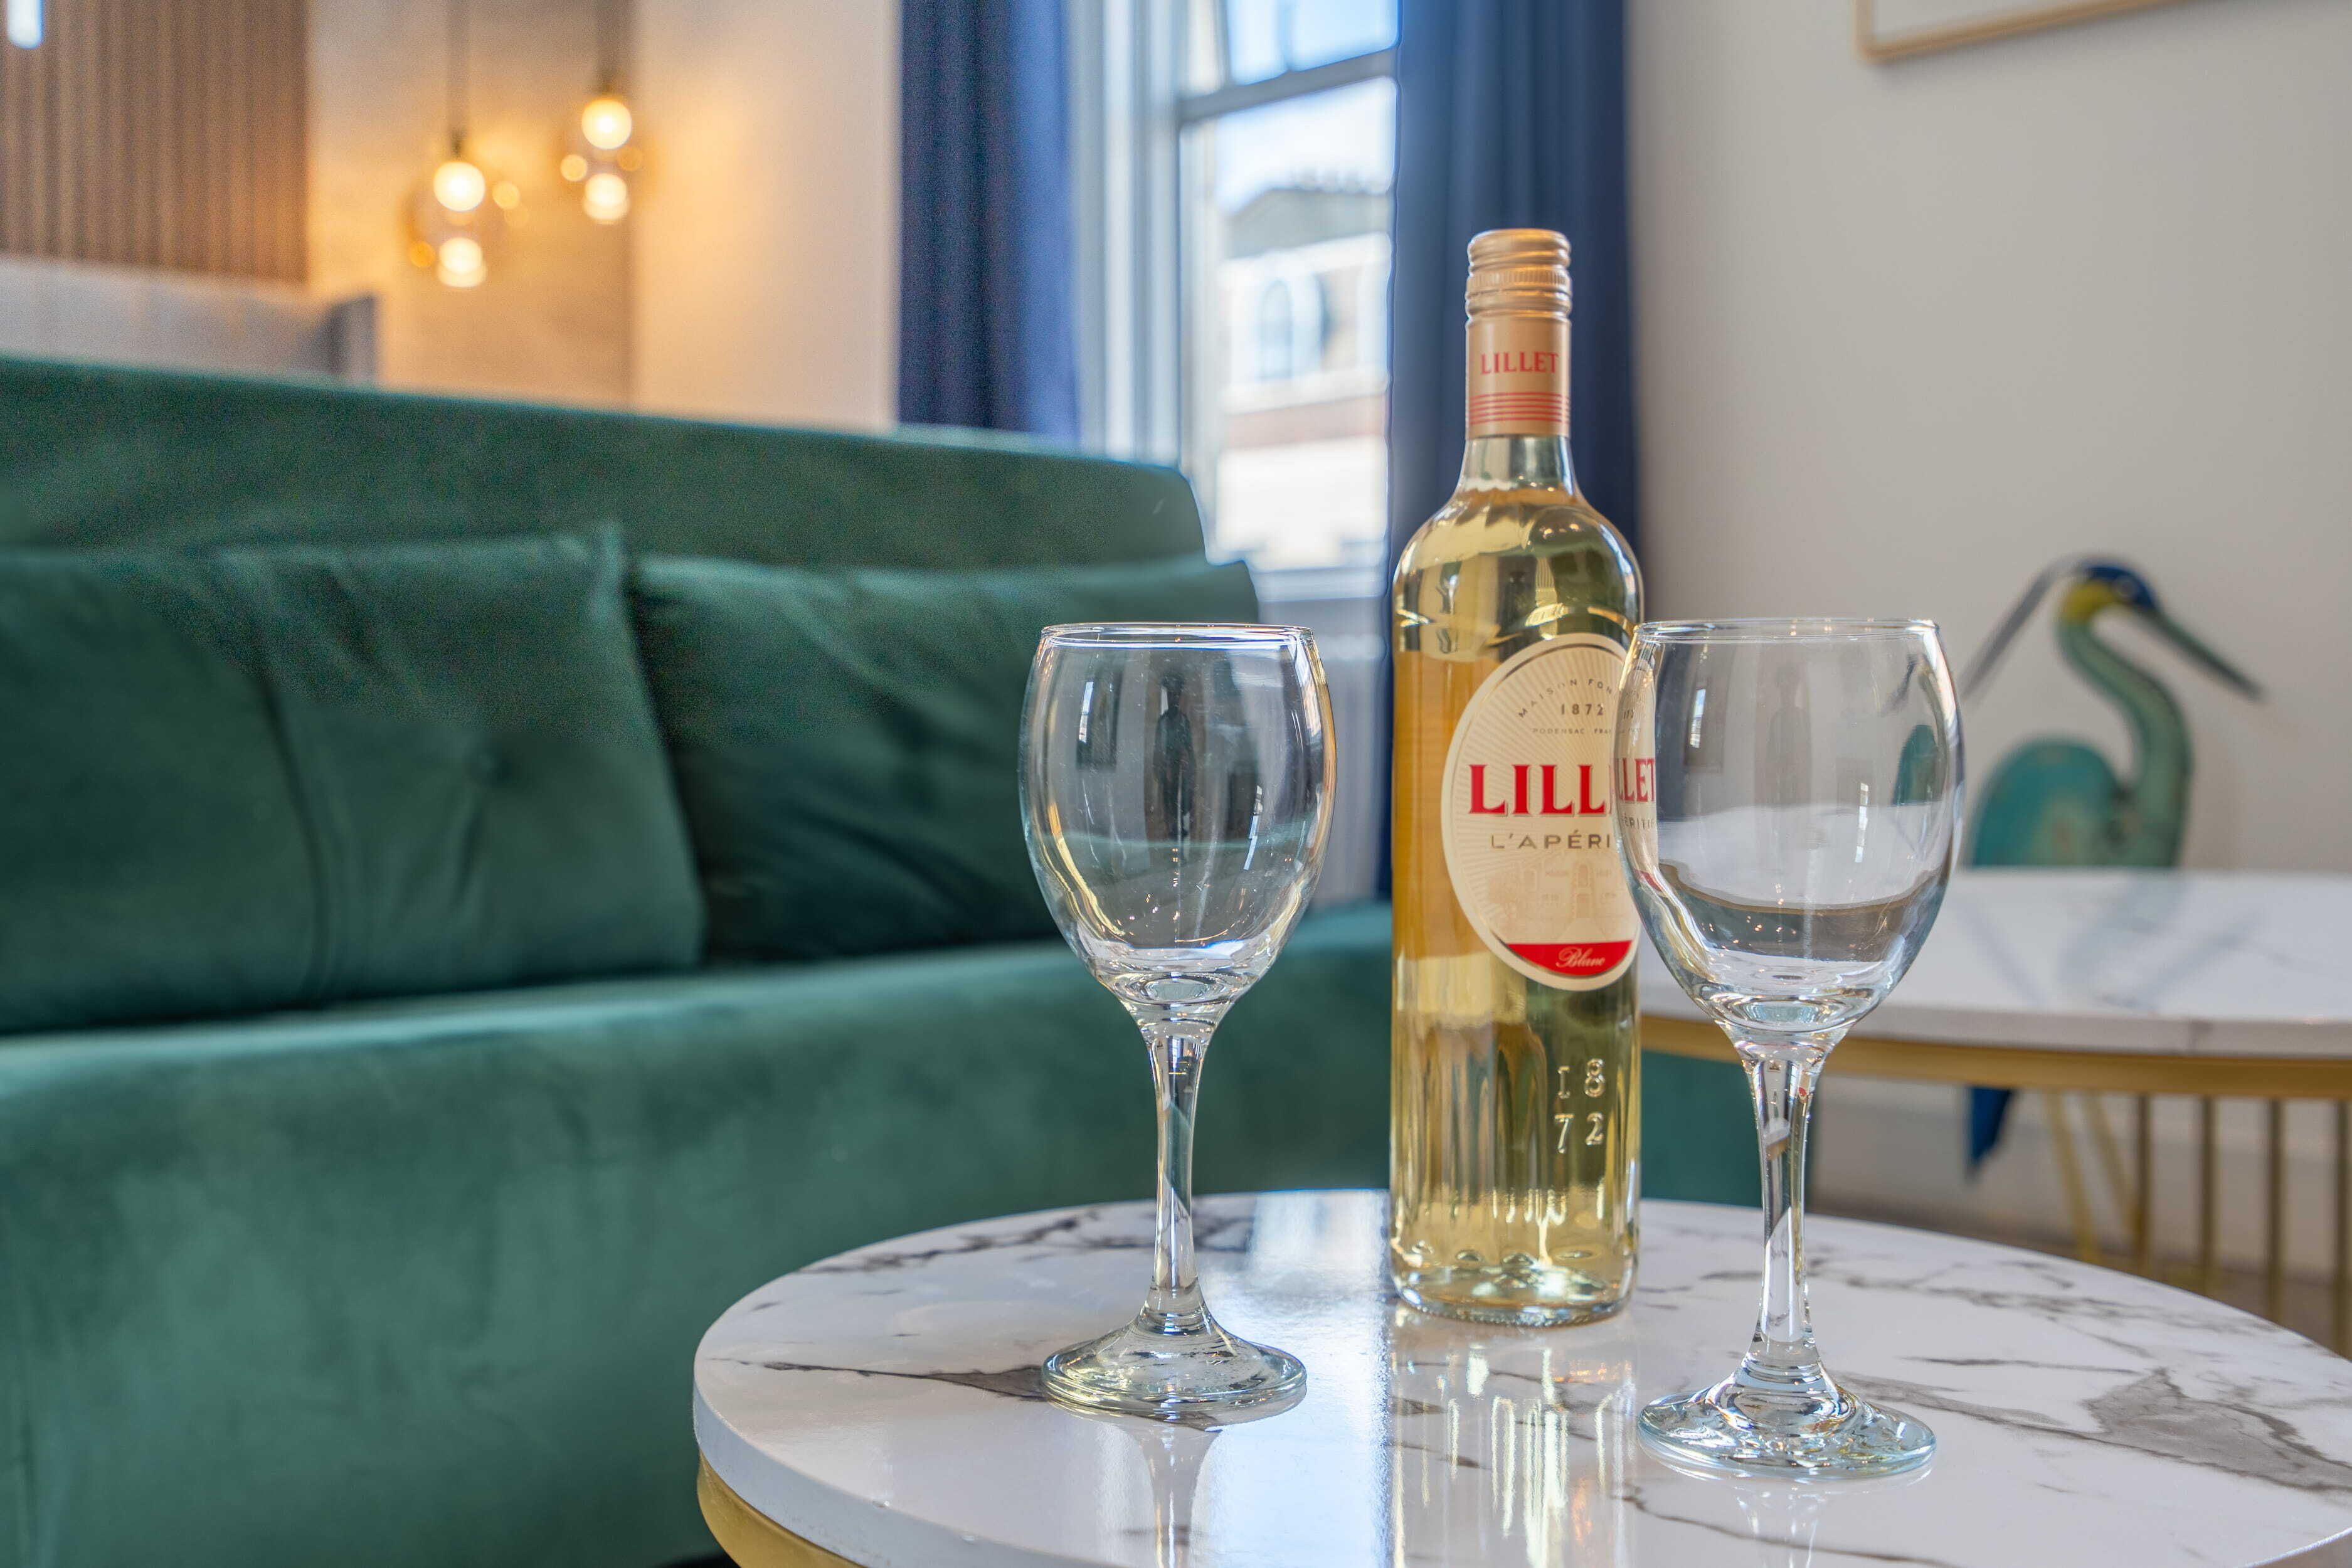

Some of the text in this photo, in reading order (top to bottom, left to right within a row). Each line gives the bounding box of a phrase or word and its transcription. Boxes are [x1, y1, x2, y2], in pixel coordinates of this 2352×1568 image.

[1481, 351, 1558, 374] LILLET
[1518, 679, 1577, 718] MAISON
[1560, 703, 1604, 716] 1872
[1468, 764, 1611, 815] LILL
[1555, 946, 1606, 968] Blanc
